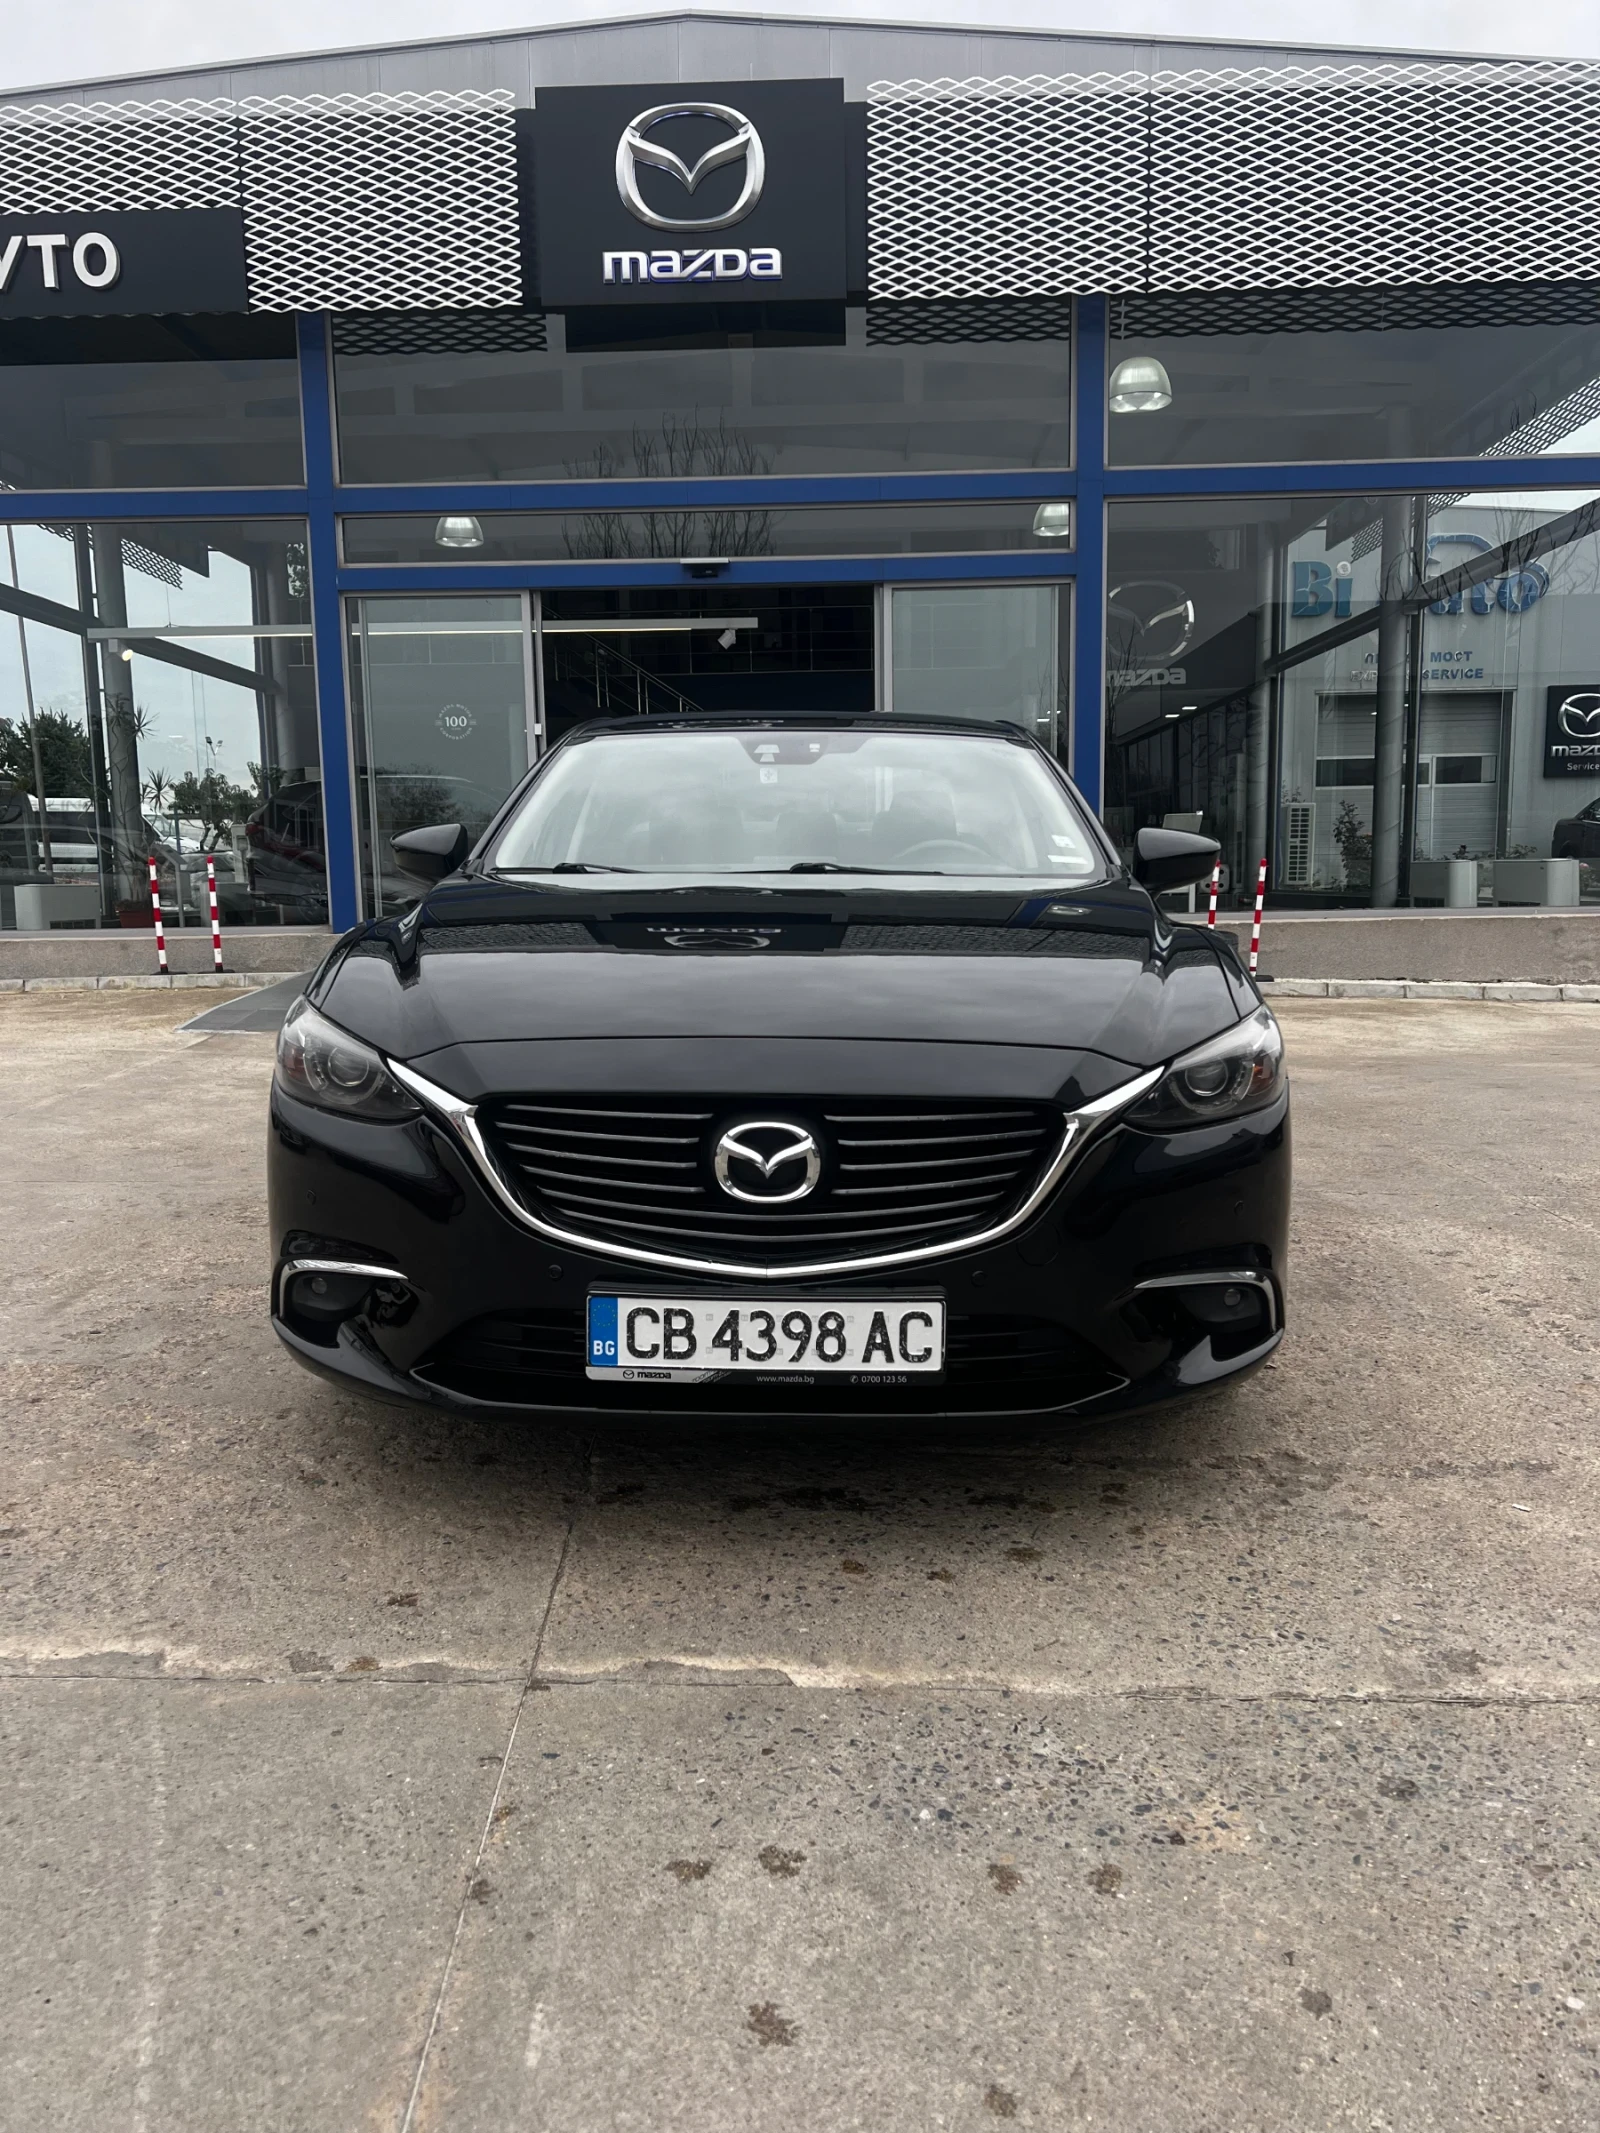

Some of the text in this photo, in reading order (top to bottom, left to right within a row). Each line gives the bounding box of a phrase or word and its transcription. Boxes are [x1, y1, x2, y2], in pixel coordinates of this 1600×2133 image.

[602, 247, 782, 284] mazda
[1421, 668, 1484, 680] SERVICE
[444, 715, 468, 727] 100
[626, 1306, 933, 1363] CB 4398 AC
[593, 1340, 615, 1356] BG
[637, 1371, 672, 1380] mazda
[756, 1374, 815, 1385] www.mazda.bg
[861, 1375, 907, 1384] 0700 123 56
